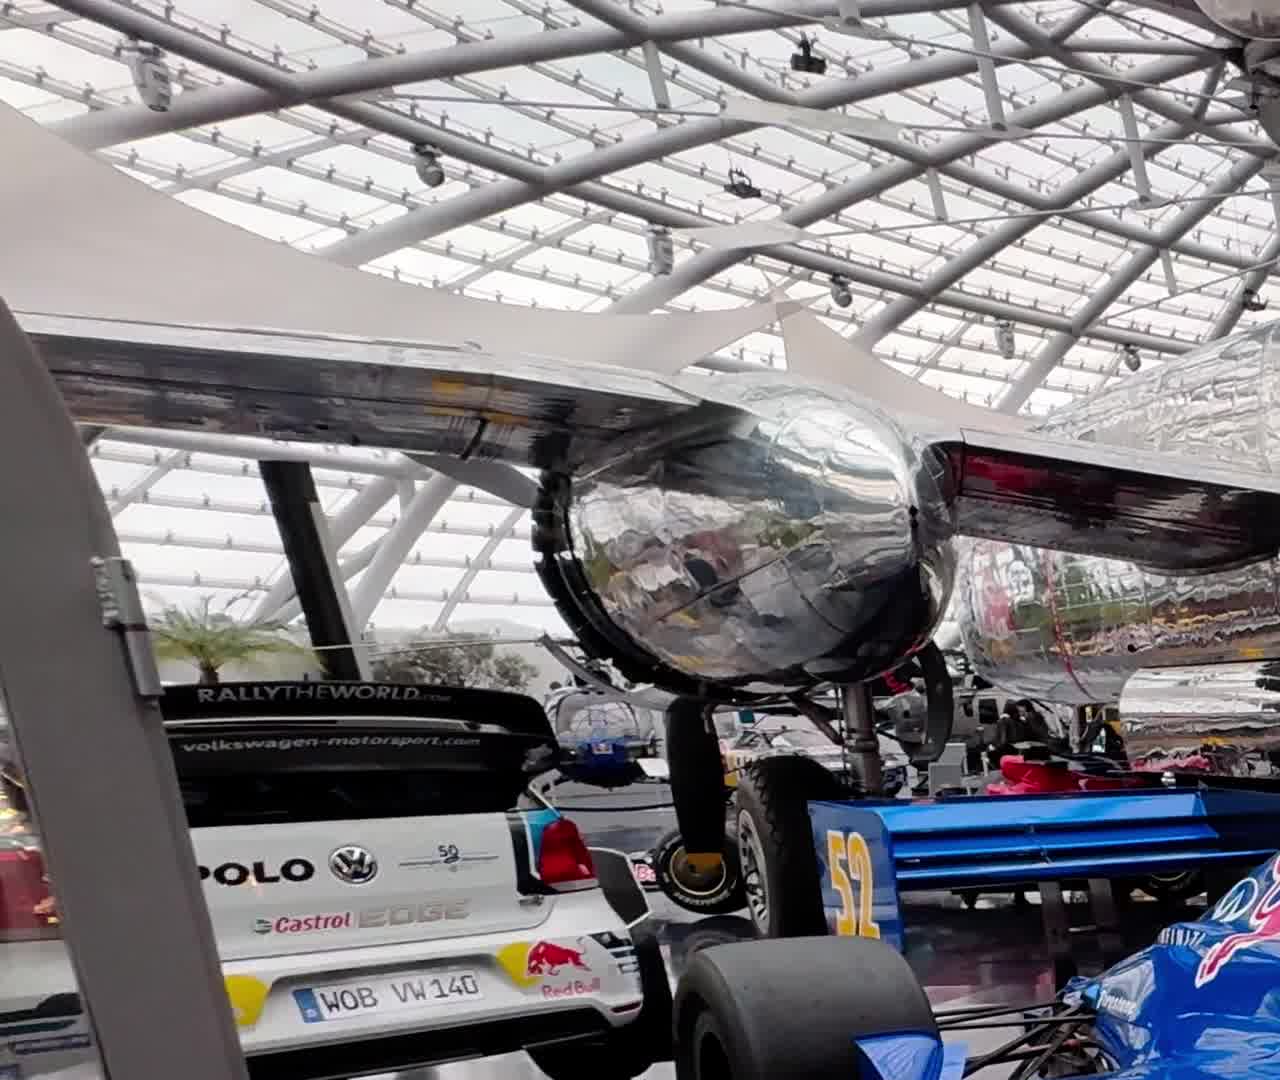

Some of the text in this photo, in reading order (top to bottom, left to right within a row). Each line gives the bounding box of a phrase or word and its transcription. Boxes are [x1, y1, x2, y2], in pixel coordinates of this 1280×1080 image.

[826, 829, 881, 938] 52
[275, 900, 470, 934] Castrol EDGE
[319, 986, 379, 1013] WOB
[391, 981, 427, 1003] VW
